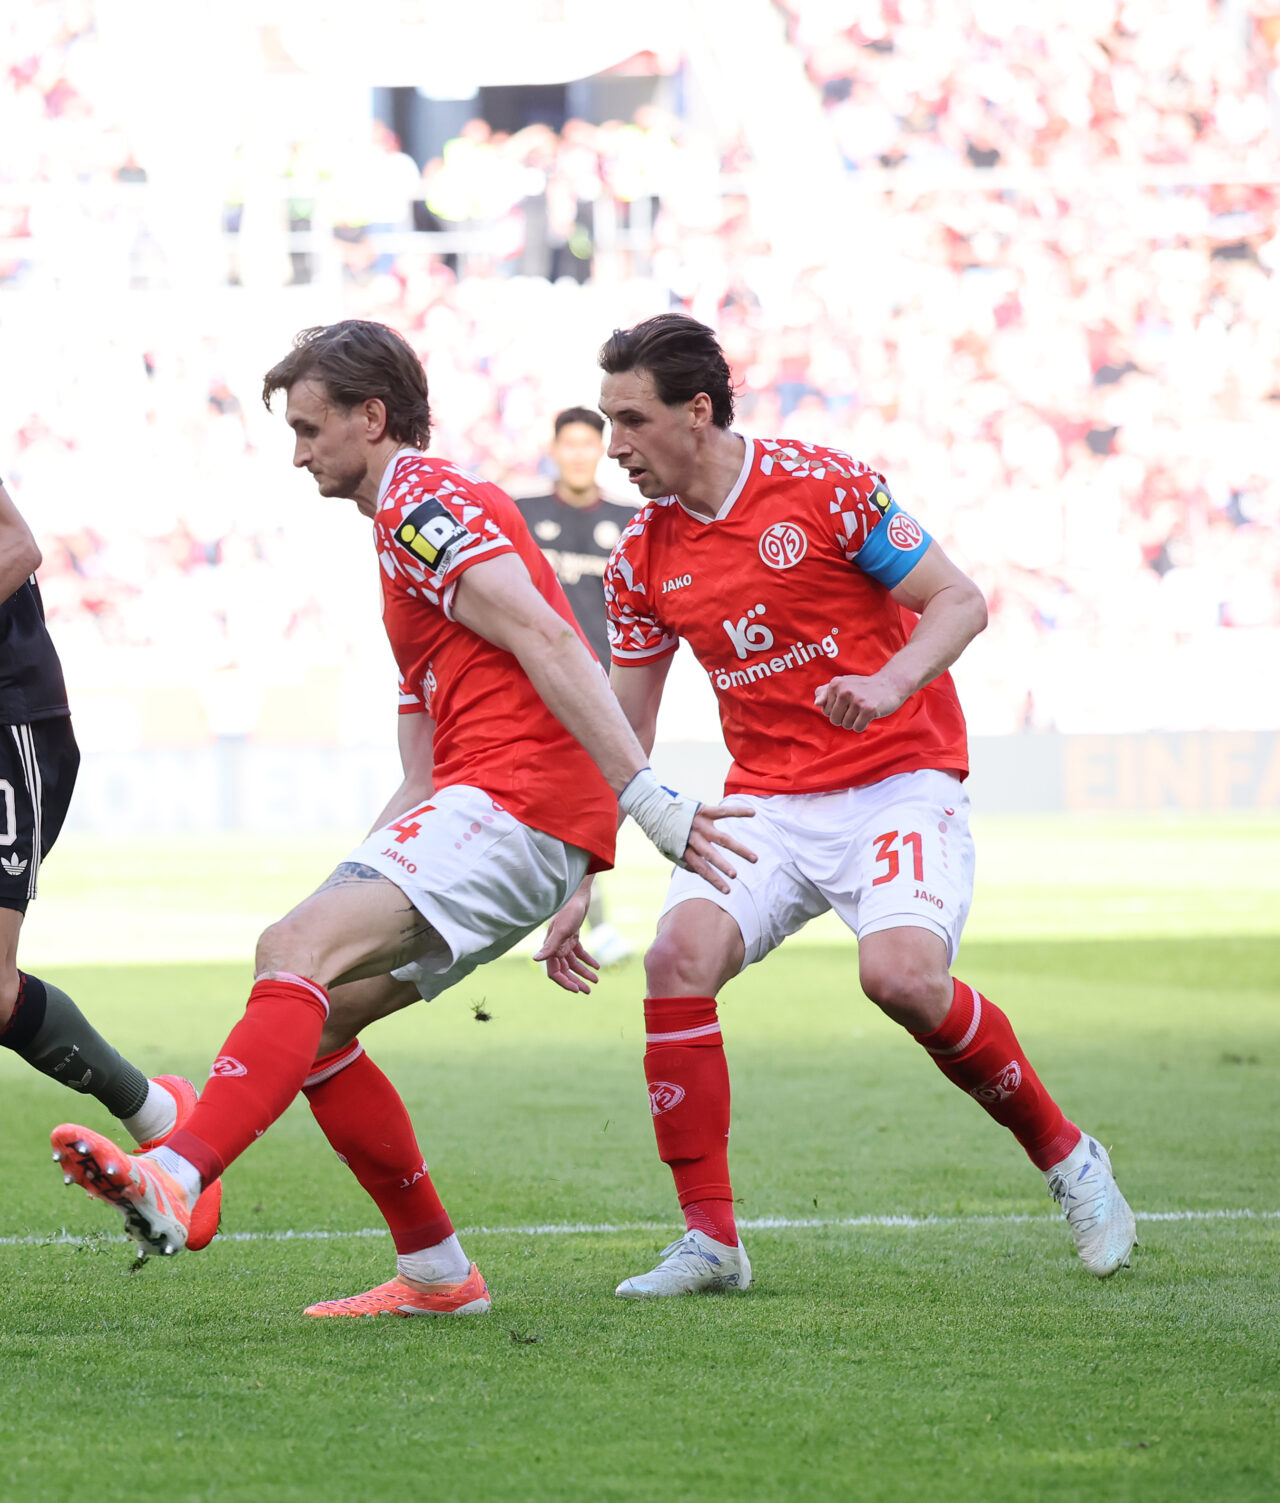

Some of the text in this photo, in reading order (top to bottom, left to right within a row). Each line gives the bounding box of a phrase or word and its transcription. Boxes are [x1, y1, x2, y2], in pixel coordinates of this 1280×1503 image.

[661, 574, 692, 594] JAKO
[387, 805, 437, 844] 4
[381, 848, 418, 874] JAKO
[872, 830, 924, 886] 31
[914, 890, 944, 909] JAKO
